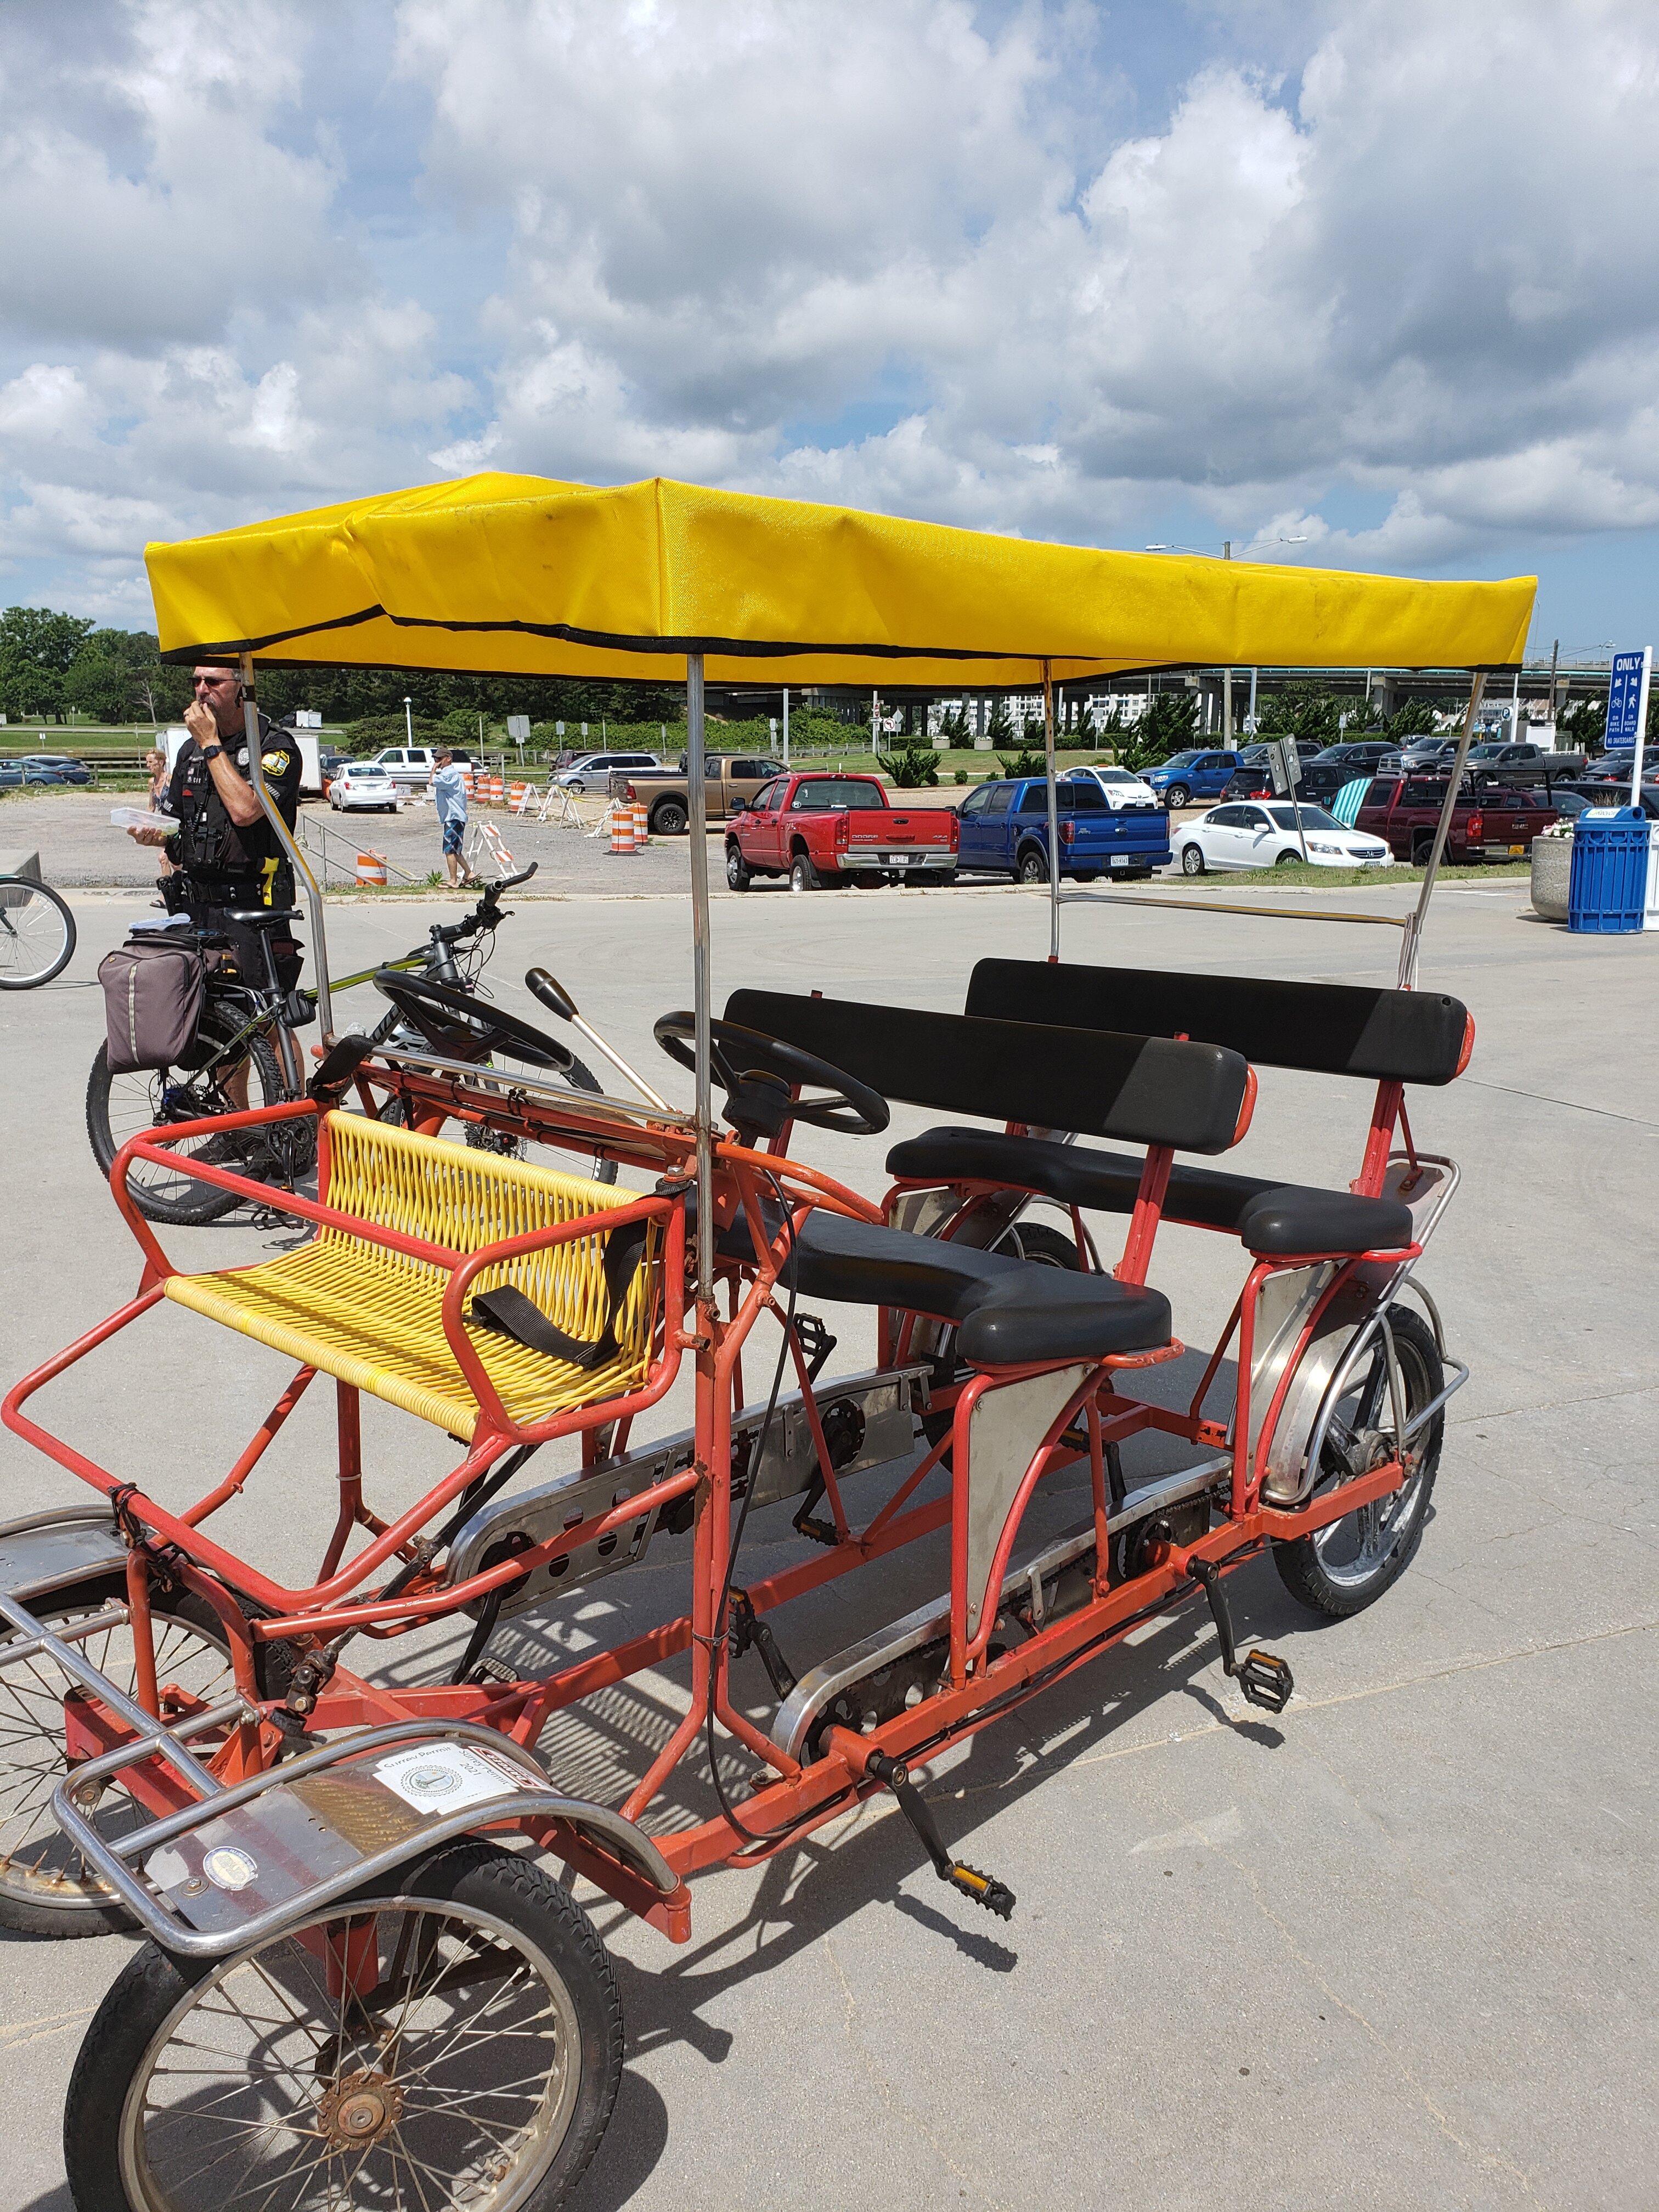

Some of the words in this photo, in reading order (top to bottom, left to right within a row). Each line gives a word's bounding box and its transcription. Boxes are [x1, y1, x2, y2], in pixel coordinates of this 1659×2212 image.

[1616, 657, 1641, 672] ONLY
[459, 1750, 483, 1767] Surrey
[459, 1763, 482, 1776] 2021
